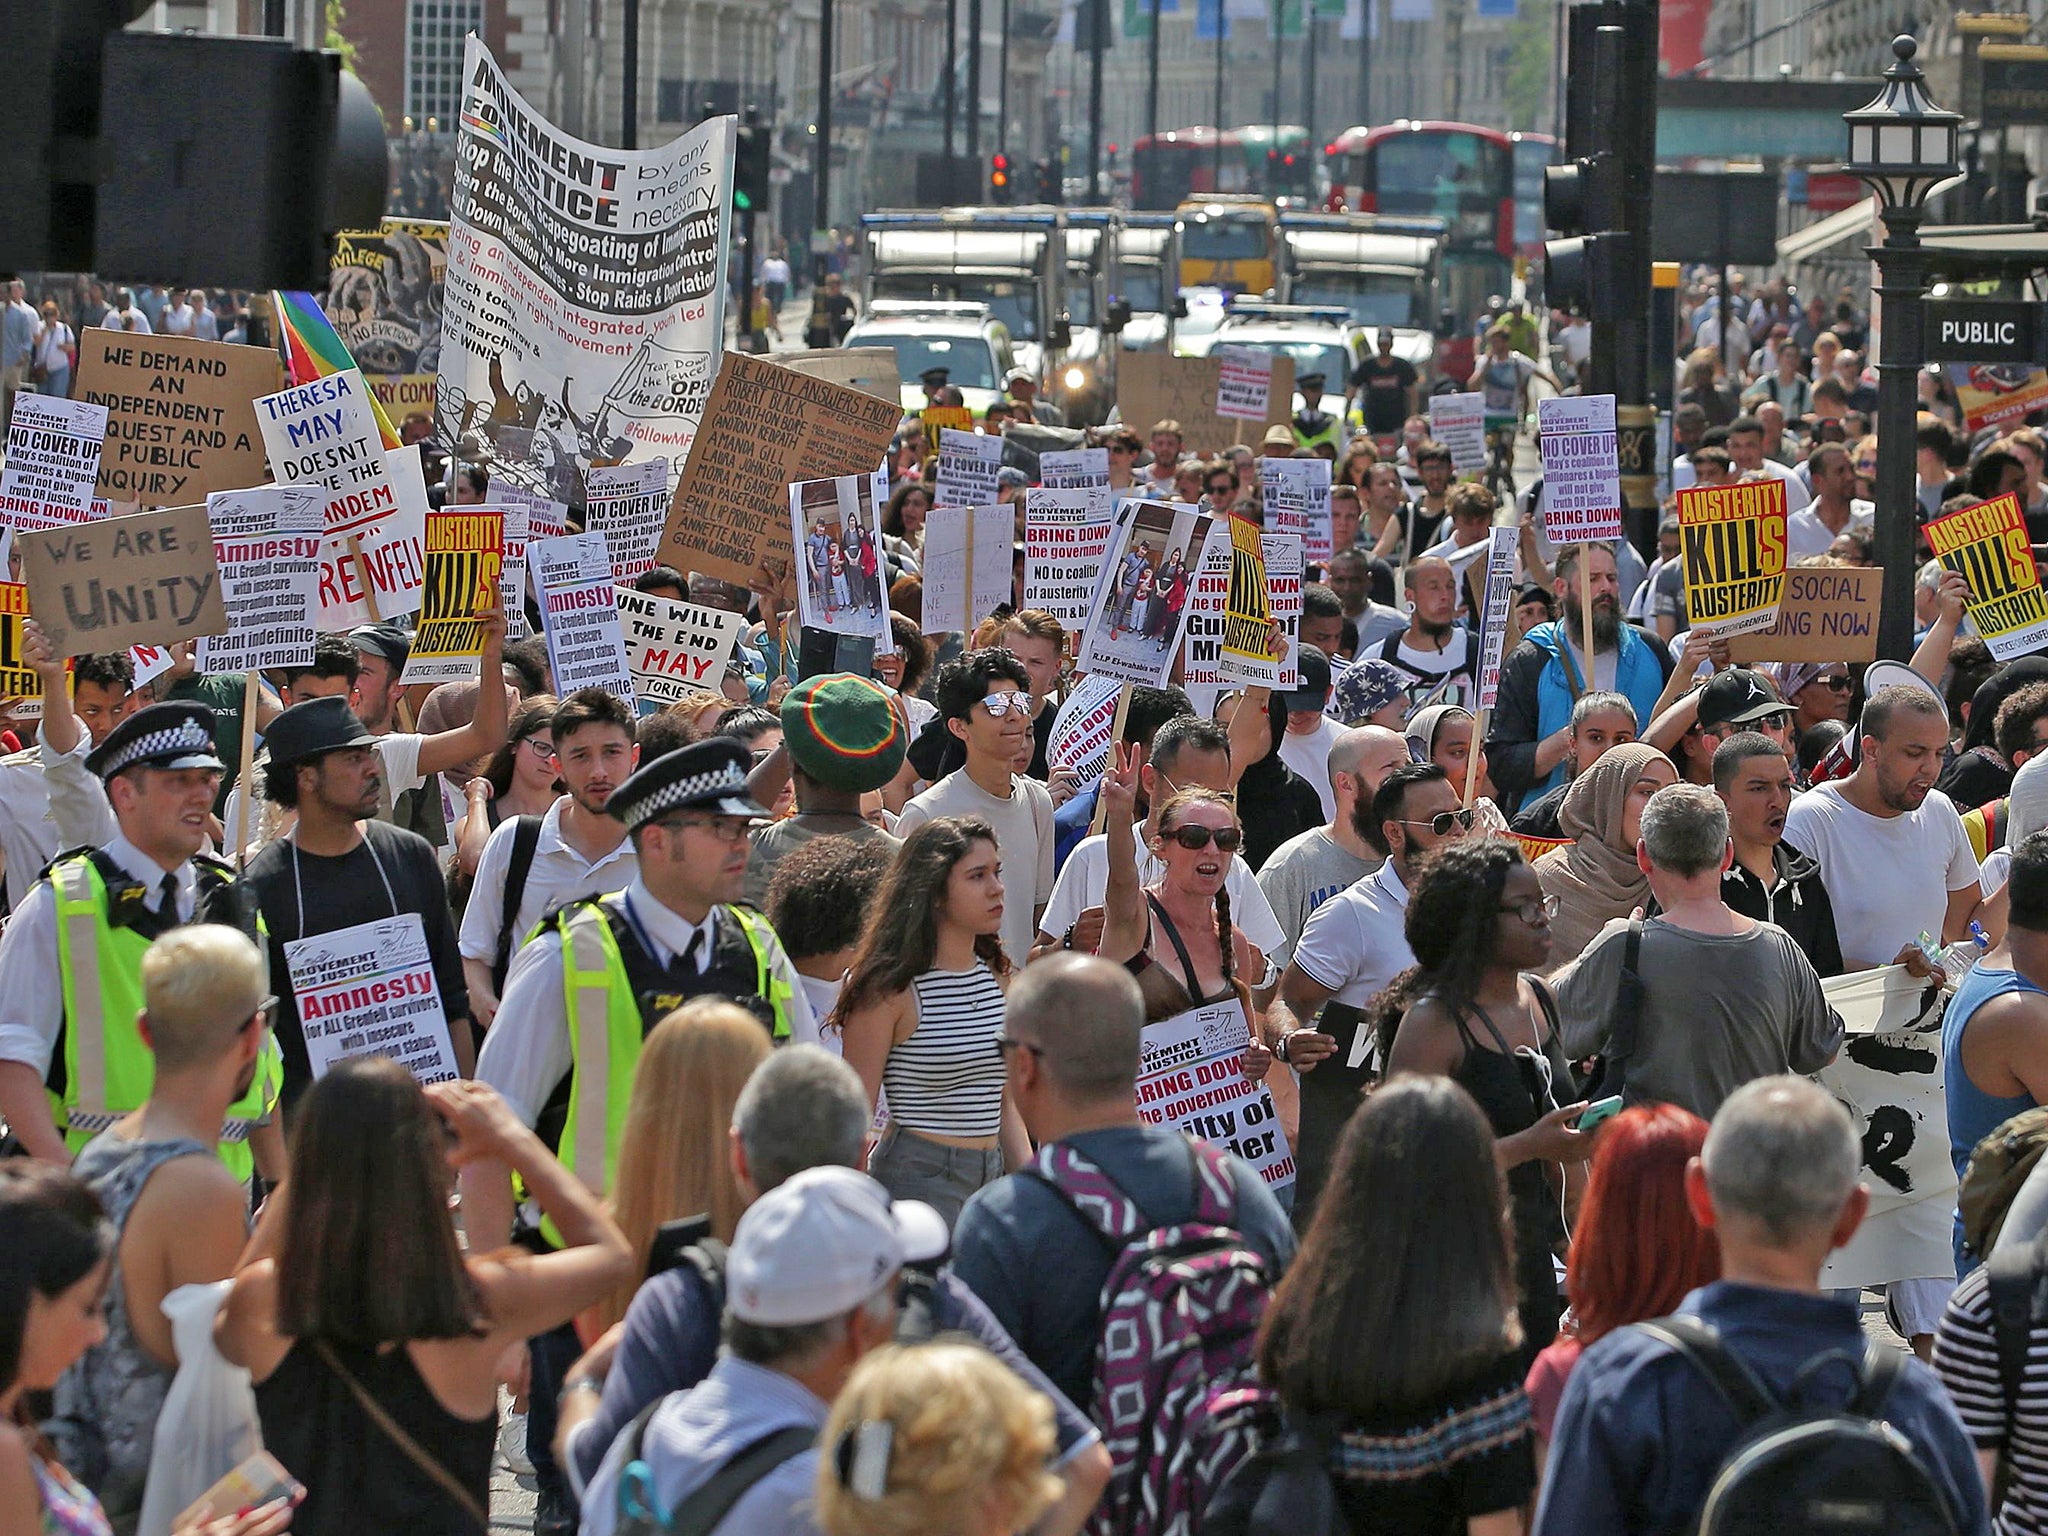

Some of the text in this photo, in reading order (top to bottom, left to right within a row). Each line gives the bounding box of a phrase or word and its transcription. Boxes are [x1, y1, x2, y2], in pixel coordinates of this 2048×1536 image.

[466, 96, 509, 133] FOR
[472, 57, 626, 191] MOVEMENT
[638, 139, 709, 181] by any
[509, 134, 619, 227] JUSTICE
[637, 162, 711, 201] means
[457, 129, 658, 265] Stop the Scapegoating of
[632, 184, 716, 228] necessary
[484, 180, 675, 287] the More Immigration
[466, 198, 651, 309] Down Stop Raids
[487, 247, 705, 336] an integrated, youth led
[470, 259, 633, 356] immigrant rights movement
[353, 322, 414, 346] NO EVICTIONS
[465, 321, 524, 362] marching
[1942, 321, 2015, 344] PUBLIC
[104, 347, 227, 377] WE DEMAND
[647, 355, 708, 372] Tear Down
[150, 376, 184, 394] AN
[642, 363, 706, 388] the fences
[262, 377, 351, 420] THERESA
[723, 380, 807, 418] ROBERT BLACK
[731, 359, 895, 427] WE WANT ANSWERS FROM
[14, 410, 69, 423] MOVEMENT
[86, 391, 224, 425] INDEPENDENT
[719, 399, 780, 430] JONATHON
[1982, 406, 2023, 423] TICKETS
[28, 419, 68, 430] JUSTICE
[288, 409, 341, 448] MAY
[757, 425, 800, 450] REDPATH
[10, 428, 101, 460] NO COVER UP
[181, 429, 226, 449] AND
[234, 433, 251, 451] A
[706, 431, 754, 456] AMANDA
[760, 446, 784, 466] GILL
[1542, 434, 1617, 457] NO COVER UP
[11, 448, 81, 468] May's coalition
[119, 444, 202, 468] PUBLIC
[701, 448, 736, 469] LAURA
[739, 456, 786, 483] JOHNSON
[954, 457, 986, 473] COVER
[65, 468, 95, 484] bigots
[348, 460, 382, 483] THE
[9, 485, 81, 507] truth justice
[36, 477, 74, 493] not give
[588, 480, 640, 491] MOVEMENT
[690, 480, 714, 498] NICK
[43, 504, 89, 522] DOWN
[587, 493, 667, 520] NO COVER UP
[1682, 483, 1783, 523] AUSTERITY
[210, 512, 277, 526] MOVEMENT
[231, 521, 277, 533] JUSTICE
[617, 514, 653, 527] coalition
[678, 517, 729, 541] ANNETTE
[728, 507, 770, 535] PRINGLE
[1545, 507, 1621, 526] BRING DOWN
[1928, 496, 2019, 554] AUSTERITY
[45, 527, 180, 564] WE ARE
[427, 516, 501, 550] AUSTERITY
[1027, 528, 1074, 542] BRING
[1547, 525, 1622, 541] the government
[213, 538, 320, 563] Amnesty
[673, 531, 755, 566] GLENN WOODHEAD
[1028, 545, 1047, 558] the
[1684, 517, 1784, 585] KILLS
[273, 560, 319, 576] survivors
[1035, 566, 1063, 579] NO to
[1942, 528, 2037, 607] KILLS
[424, 552, 500, 619] KILLS
[1027, 586, 1037, 599] of
[1691, 576, 1784, 619] AUSTERITY
[1791, 576, 1866, 602] SOCIAL
[241, 608, 305, 627] undocumented
[668, 606, 724, 630] WILL
[926, 600, 941, 611] WE
[1971, 587, 2046, 635] AUSTERITY
[414, 621, 487, 653] AUSTERITY
[632, 621, 718, 650] THE END
[1822, 613, 1870, 636] NOW
[208, 628, 314, 651] Grant indefinite
[205, 646, 314, 672] leave remain!
[642, 648, 713, 680] MAY
[1092, 667, 1154, 686] never be forgotten
[292, 951, 377, 978] MOVEMENT
[320, 961, 380, 984] JUSTICE
[303, 971, 432, 1020] Amnesty
[324, 995, 439, 1035] ALL Grenfell survivors
[367, 1022, 416, 1044] insecure
[403, 1034, 437, 1053] status
[1147, 1047, 1204, 1073] JUSTICE
[1243, 1093, 1275, 1126] of
